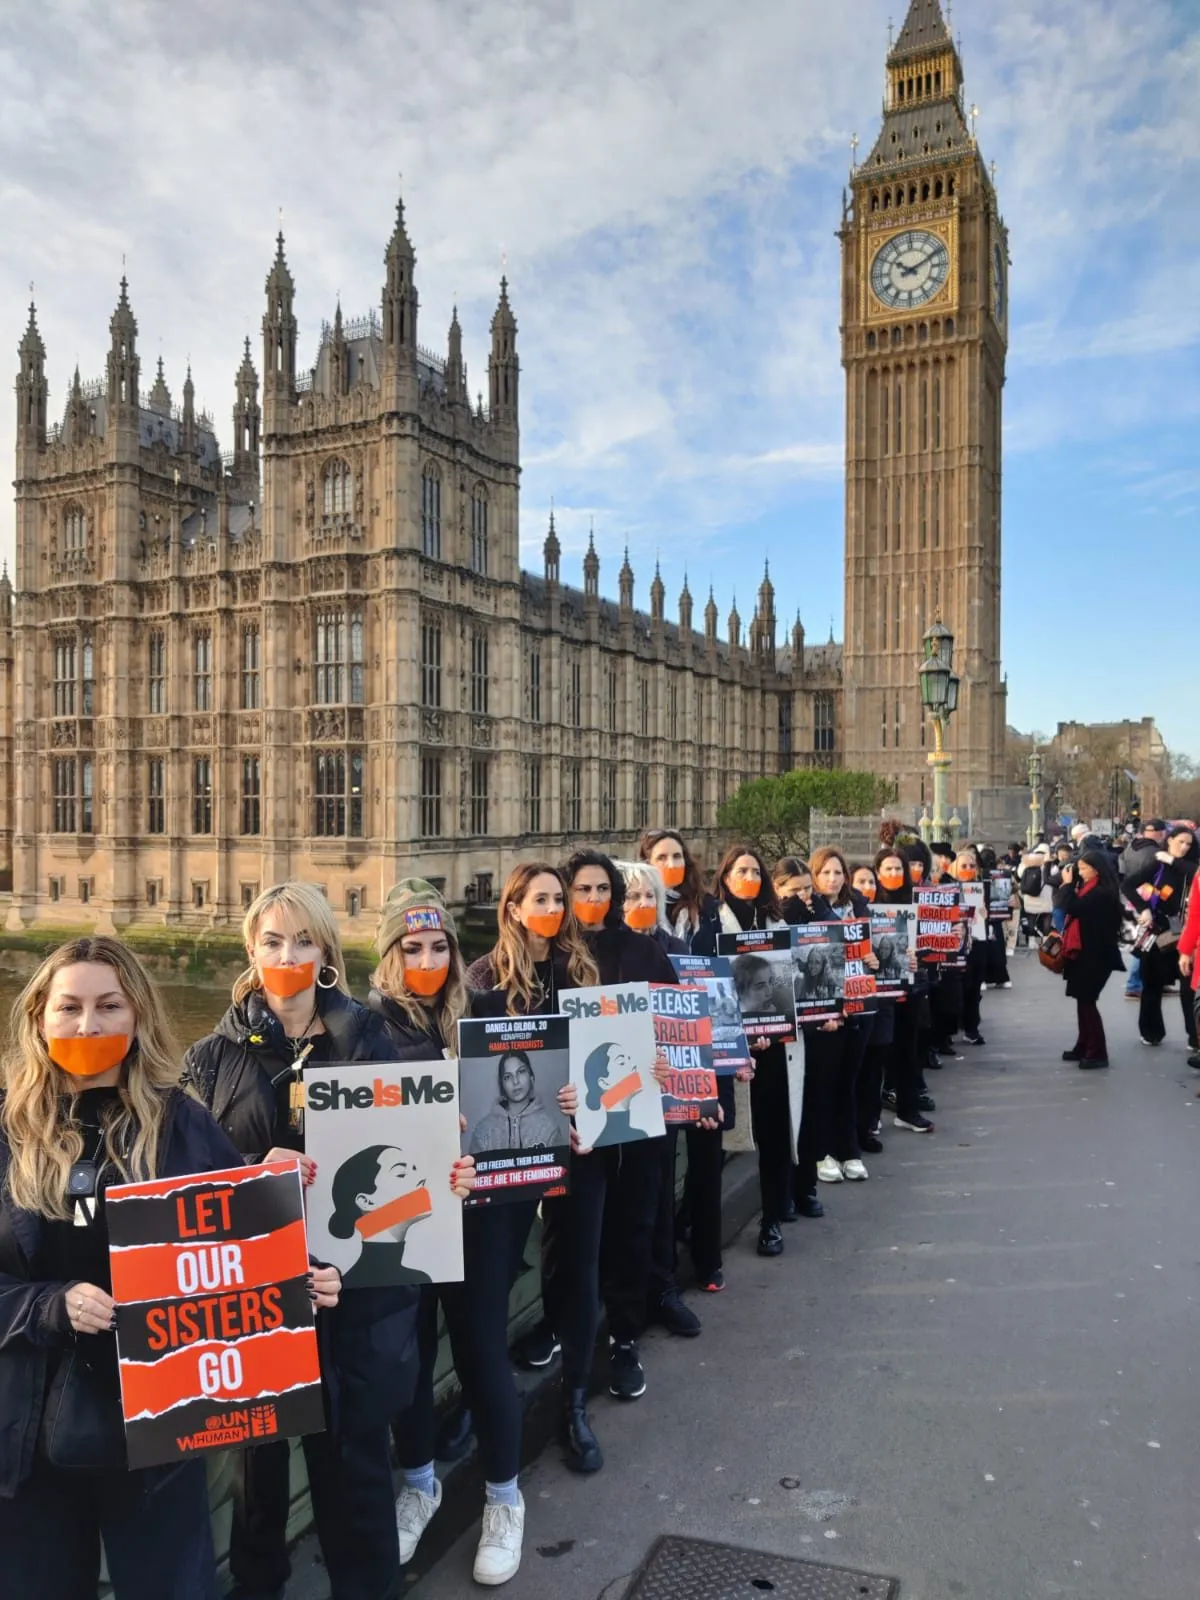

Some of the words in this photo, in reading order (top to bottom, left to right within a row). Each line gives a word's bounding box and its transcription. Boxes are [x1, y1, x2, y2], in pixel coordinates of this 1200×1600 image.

[918, 892, 955, 905] RELEASE
[919, 922, 952, 934] WOMEN
[562, 992, 648, 1019] SheIsMe
[651, 991, 700, 1015] ELEASE
[485, 1022, 512, 1033] DANIELA
[539, 1020, 547, 1030] 20
[307, 1075, 455, 1111] SheIsMe
[475, 1176, 493, 1187] HERE
[494, 1173, 508, 1185] ARE
[509, 1171, 522, 1183] THE
[523, 1166, 563, 1181] FEMINISTS?
[476, 1162, 487, 1171] HER
[176, 1188, 235, 1238] LET
[176, 1243, 244, 1294] OUR
[145, 1286, 284, 1350] SISTERS
[198, 1348, 243, 1395] GO
[221, 1409, 248, 1427] UN
[196, 1430, 240, 1444] HUMAN
